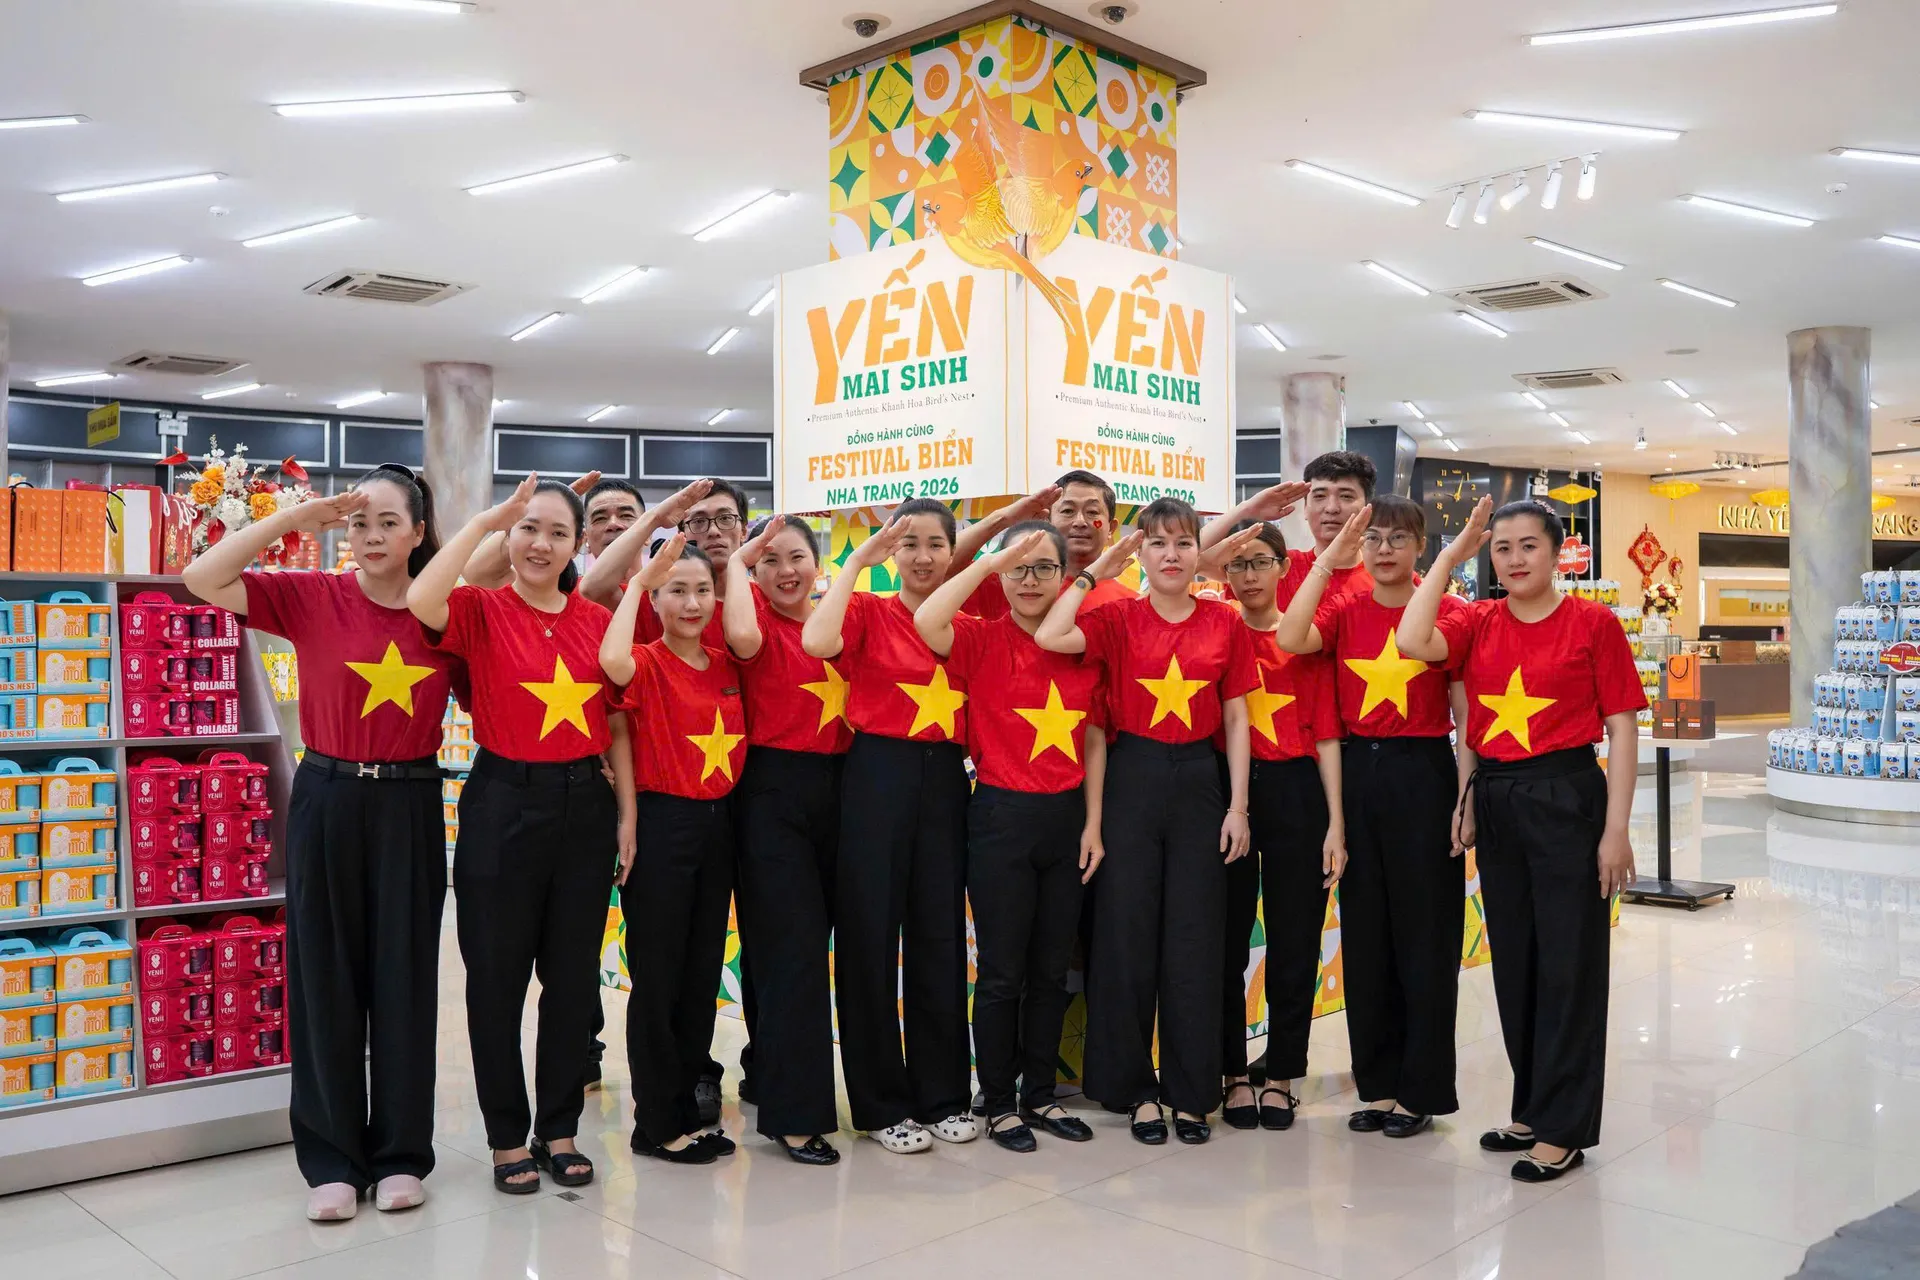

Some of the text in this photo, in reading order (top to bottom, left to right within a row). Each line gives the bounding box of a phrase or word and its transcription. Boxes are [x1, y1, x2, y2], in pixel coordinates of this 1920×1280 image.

[806, 248, 974, 406] YẾN
[1055, 266, 1205, 387] YẾN
[843, 356, 968, 401] MAI SINH
[1093, 362, 1201, 406] MAI SINH
[811, 393, 970, 423] Premium Authentic Khanh Hoa Bird's Nest
[1060, 392, 1202, 424] Premium Authentic Khanh Hoa Bird's Nest
[847, 424, 934, 445] ĐỒNG HÀNH CÙNG
[1097, 422, 1175, 446] ĐỒNG HÀNH CÙNG
[808, 429, 973, 482] FESTIVAL BIỂN
[1056, 438, 1207, 482] FESTIVAL BIỂN
[826, 477, 959, 506] NHA TRANG 2026
[1114, 482, 1161, 501] TRANG
[198, 637, 239, 648] COLLAGEN
[193, 681, 235, 691] COLLAGEN
[196, 724, 238, 734] COLLAGEN
